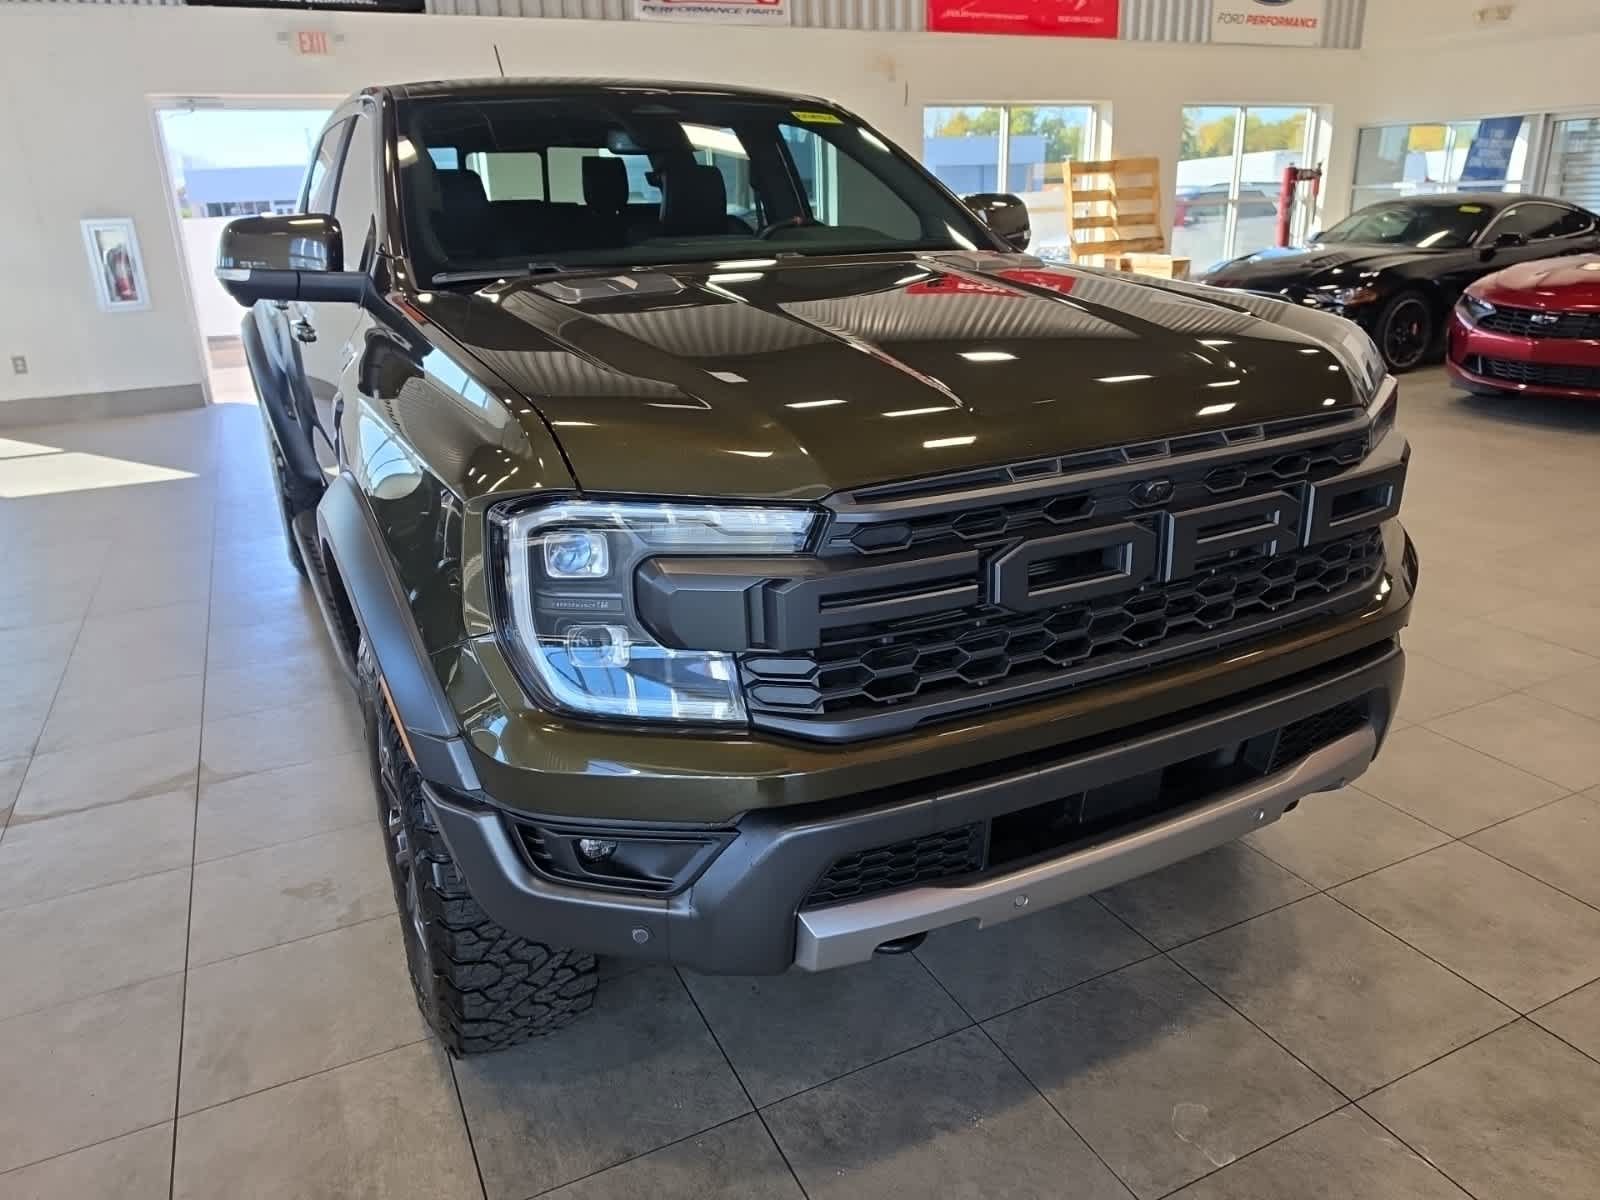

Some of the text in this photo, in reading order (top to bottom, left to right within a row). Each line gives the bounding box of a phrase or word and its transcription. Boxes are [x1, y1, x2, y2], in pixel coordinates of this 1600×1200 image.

[642, 5, 784, 16] PERFORMANCE PARTS
[1216, 13, 1318, 28] FORD PERFORMANCE
[298, 31, 328, 54] EXIT
[768, 473, 1406, 651] FORD
